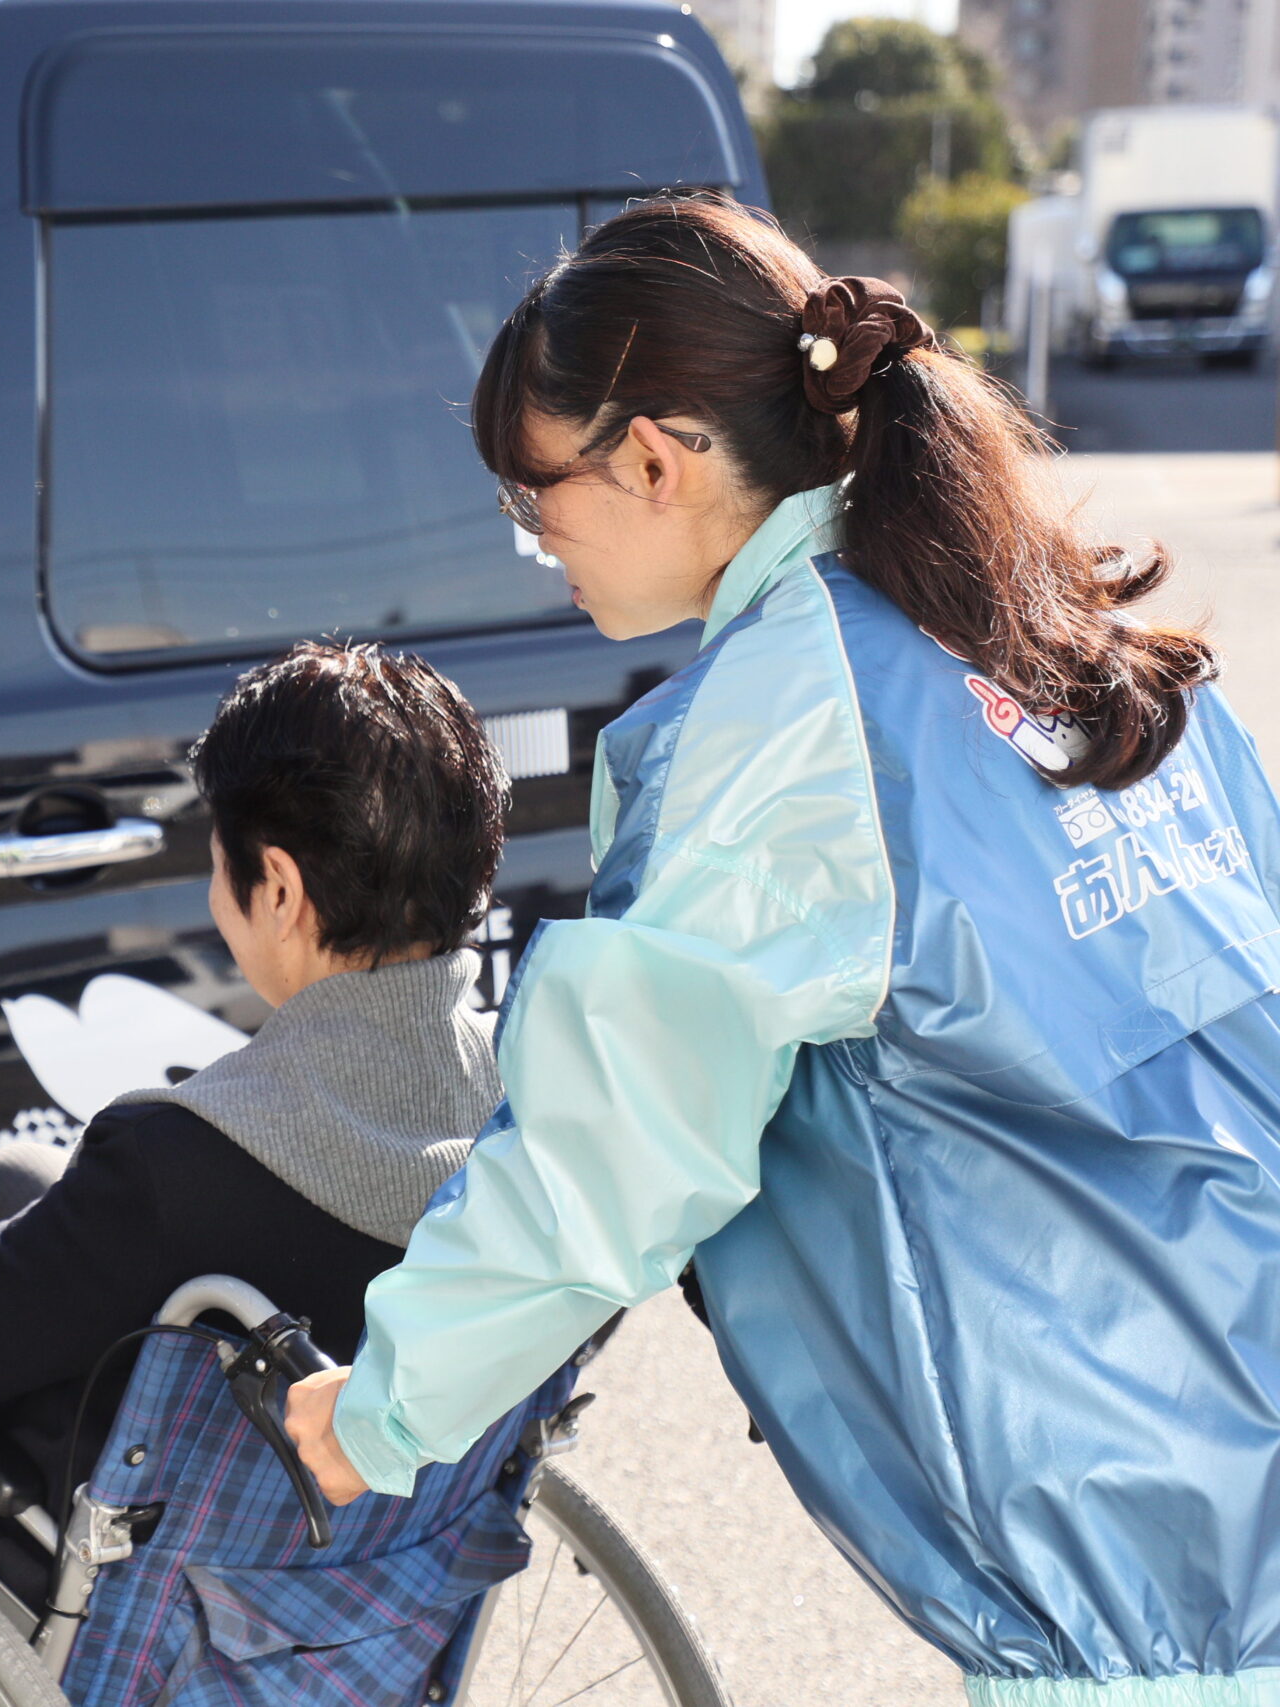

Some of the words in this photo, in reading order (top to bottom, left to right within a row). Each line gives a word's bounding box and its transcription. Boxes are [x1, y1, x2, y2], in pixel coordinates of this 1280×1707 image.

[1053, 788, 1097, 815] フリーダイヤル
